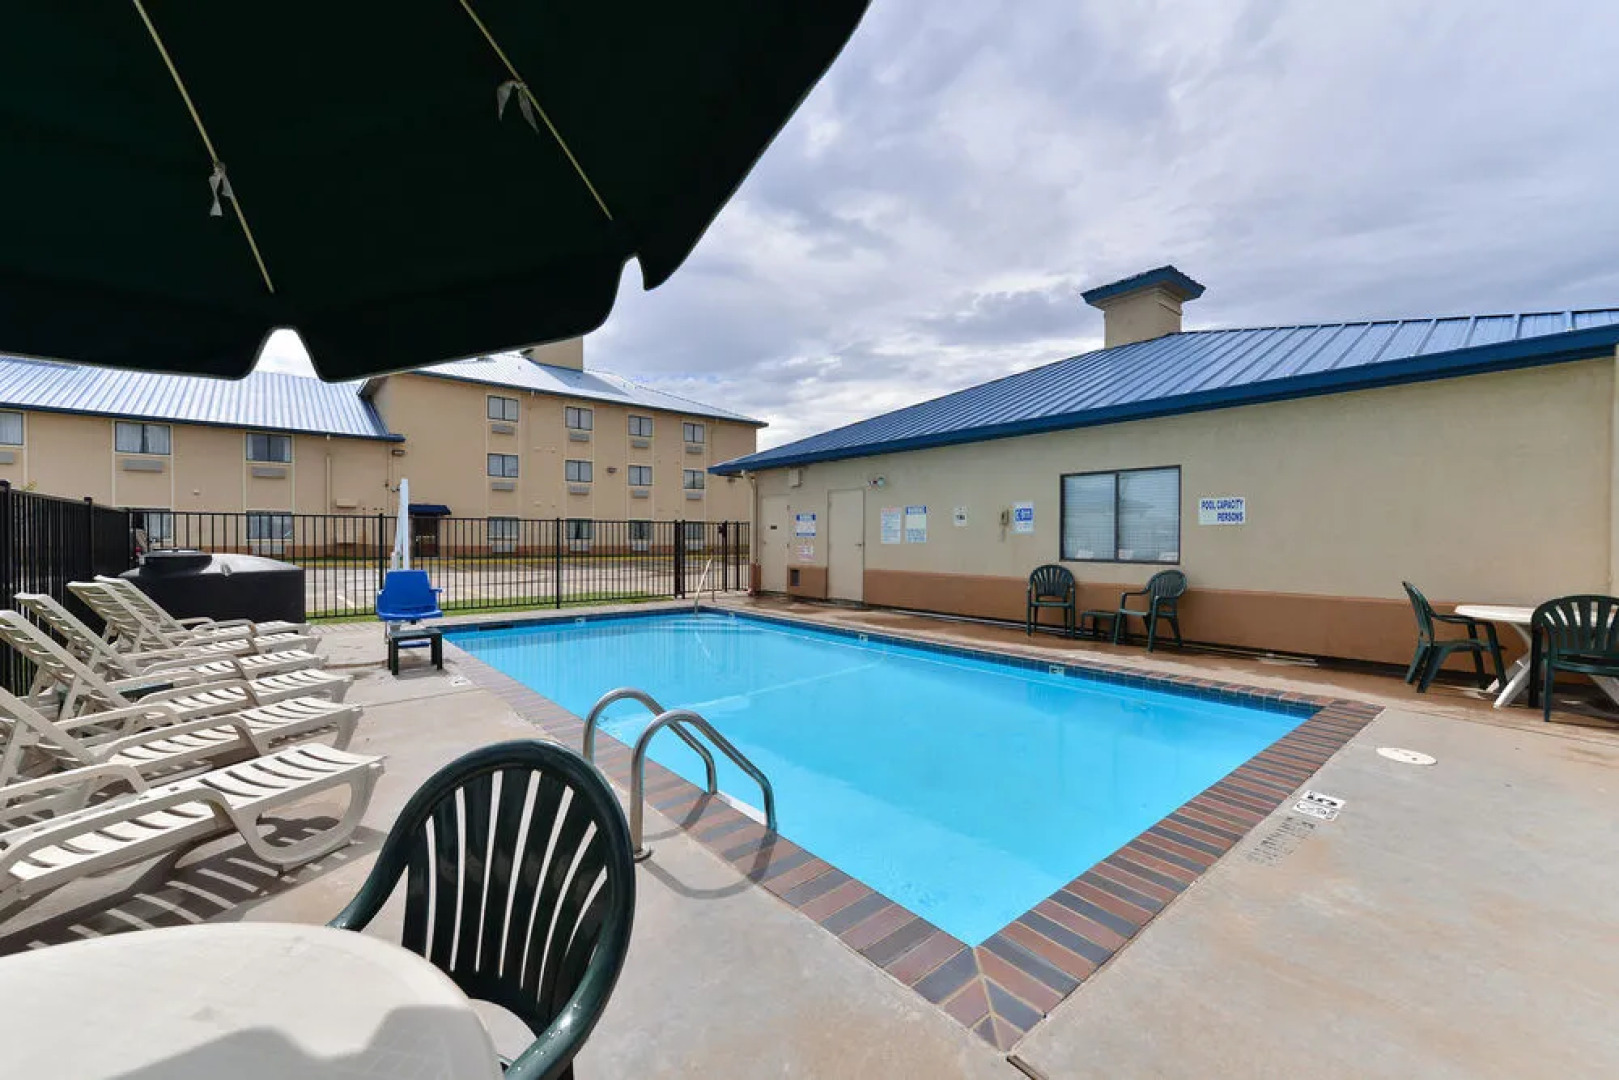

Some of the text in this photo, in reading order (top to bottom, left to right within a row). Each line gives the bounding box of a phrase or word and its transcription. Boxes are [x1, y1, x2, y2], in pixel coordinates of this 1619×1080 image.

[1201, 499, 1243, 510] POOL CAPACITY
[1217, 512, 1243, 521] PERSONS
